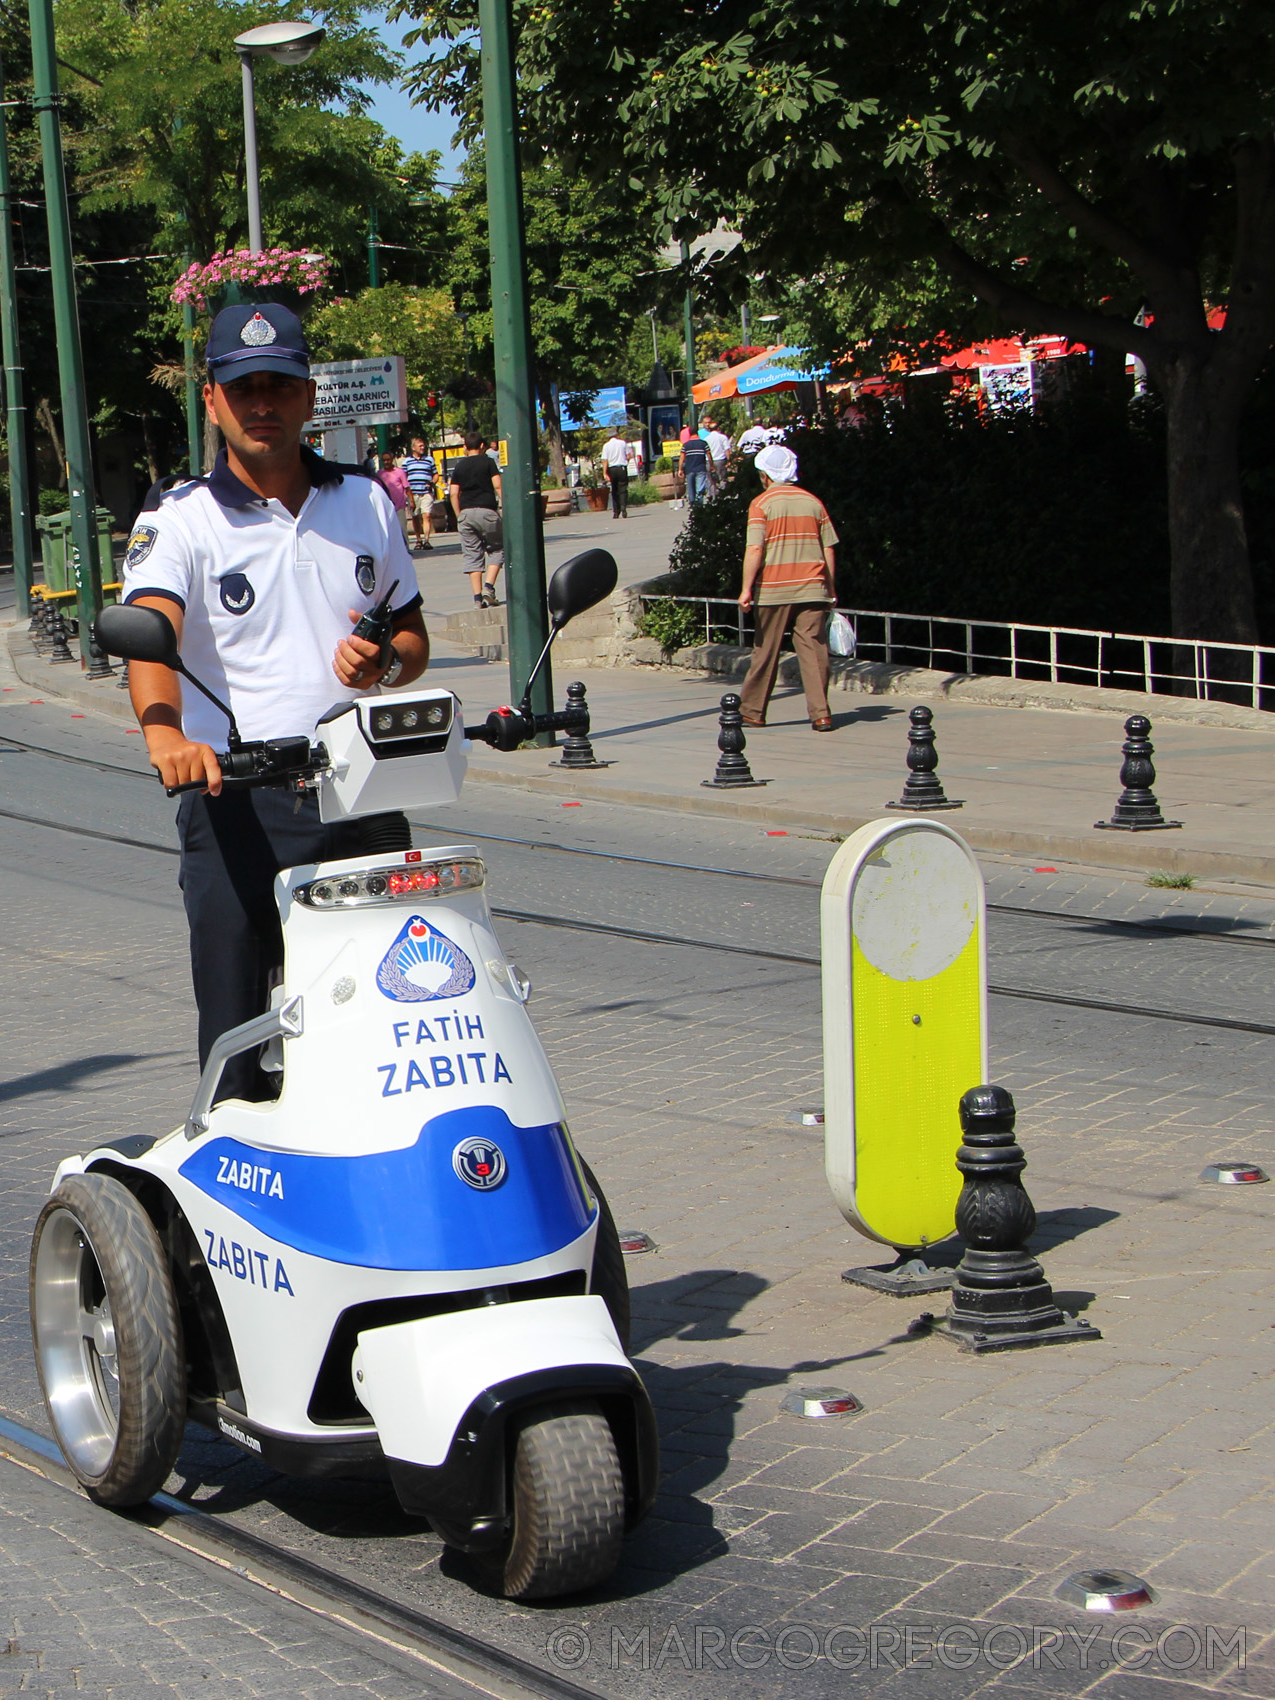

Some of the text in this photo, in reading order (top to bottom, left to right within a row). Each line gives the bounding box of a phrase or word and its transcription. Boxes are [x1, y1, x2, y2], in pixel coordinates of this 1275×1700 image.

[317, 381, 349, 391] KÜLTÜR
[745, 370, 796, 387] Dondurma
[312, 400, 396, 416] BASILICA CISTERN
[315, 390, 390, 405] EBATAN SARNICI
[392, 1009, 485, 1048] FATİH
[377, 1052, 513, 1098] ZABITA
[216, 1156, 285, 1200] ZABITA
[204, 1228, 295, 1297] ZABITA
